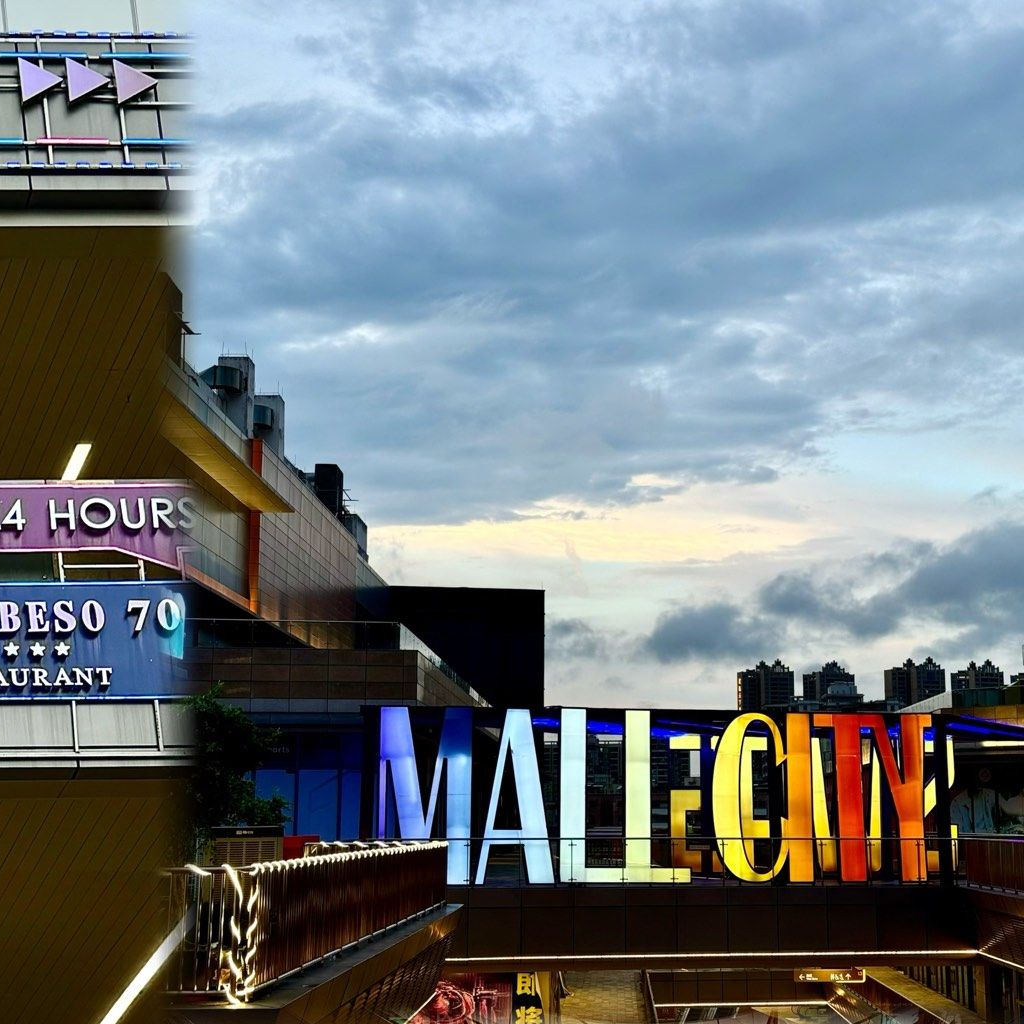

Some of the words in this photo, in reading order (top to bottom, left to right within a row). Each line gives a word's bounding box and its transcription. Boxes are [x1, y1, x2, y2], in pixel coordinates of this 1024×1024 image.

[48, 497, 196, 529] HOURS
[126, 600, 180, 632] 70
[379, 706, 692, 885] MALL
[711, 712, 932, 884] CITY
